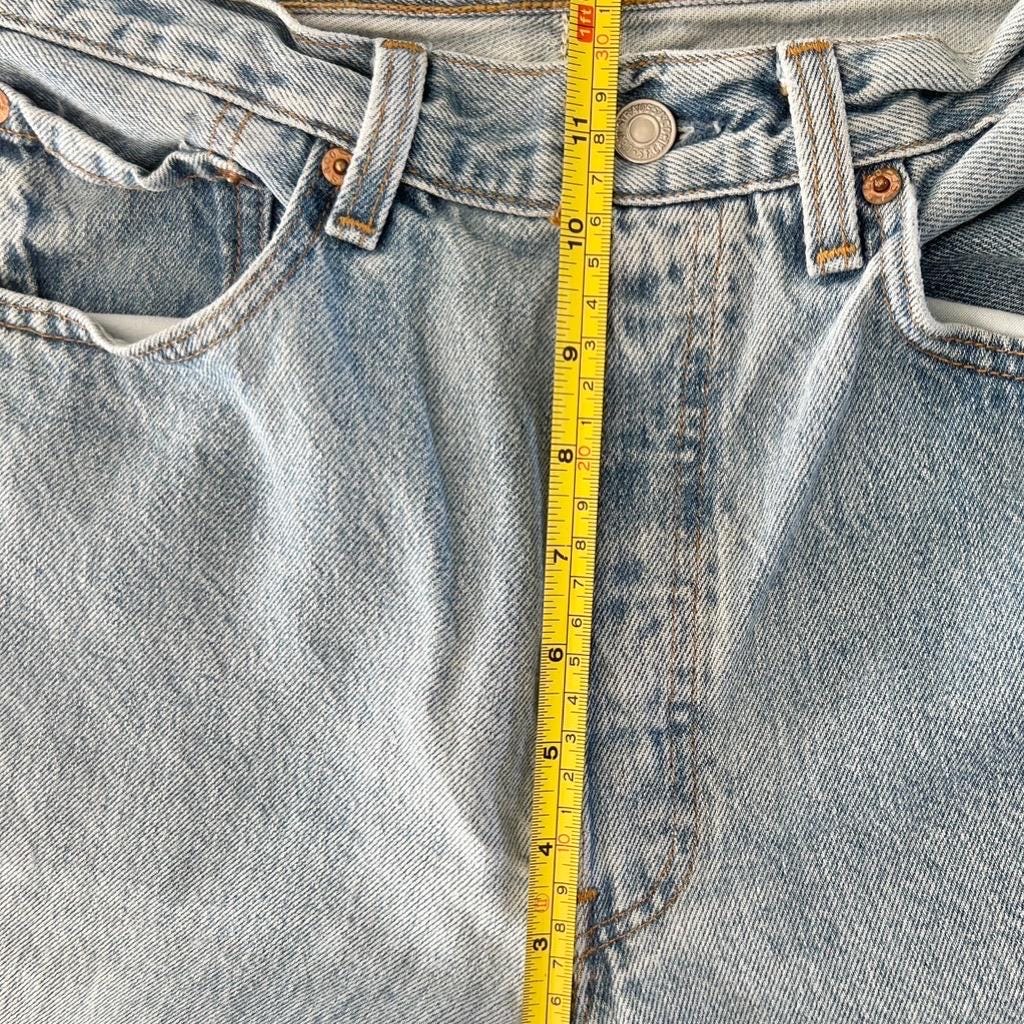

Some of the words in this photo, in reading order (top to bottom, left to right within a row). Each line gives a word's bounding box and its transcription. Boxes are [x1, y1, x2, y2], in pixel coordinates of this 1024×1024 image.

[580, 8, 593, 36] 1ft
[596, 34, 609, 60] 30
[595, 92, 606, 102] 9
[572, 117, 588, 145] 11
[594, 133, 605, 144] 8
[592, 175, 603, 185] 7
[590, 216, 601, 226] 6
[568, 218, 583, 250] 10
[588, 258, 599, 268] 5
[587, 299, 598, 309] 4
[584, 340, 596, 350] 3
[562, 346, 578, 361] 9
[583, 380, 594, 391] 2
[558, 449, 573, 463] 8
[578, 446, 591, 471] 20
[577, 501, 588, 511] 9
[575, 540, 586, 550] 8
[553, 549, 569, 563] 7
[573, 579, 584, 588] 7
[572, 618, 583, 628] 6
[548, 647, 563, 662] 6
[569, 656, 580, 666] 5
[568, 695, 578, 705] 4
[566, 733, 576, 743] 3
[543, 745, 558, 760] 5
[564, 772, 574, 782] 2
[539, 842, 553, 857] 4
[557, 885, 567, 895] 9
[555, 923, 566, 932] 8
[533, 937, 548, 951] 3
[553, 959, 563, 968] 7
[551, 996, 562, 1006] 6
